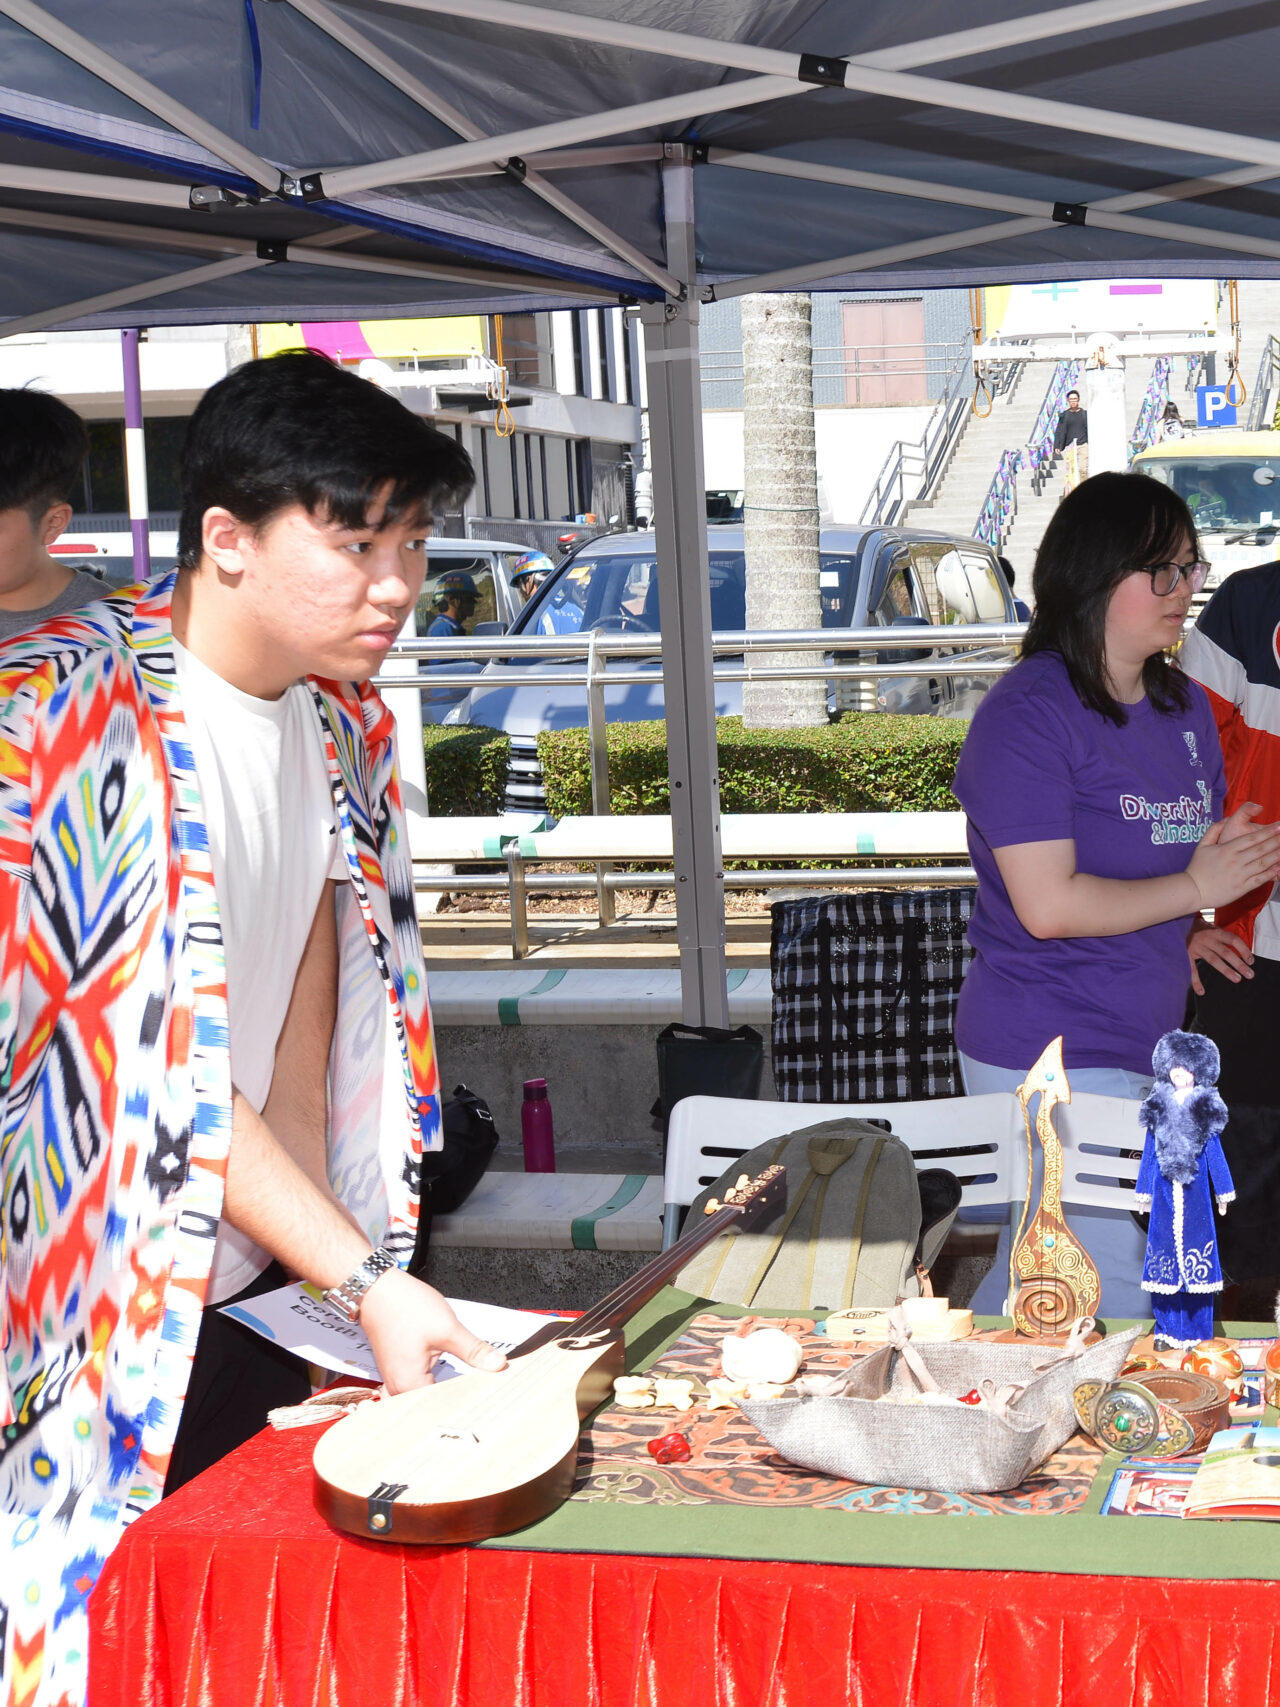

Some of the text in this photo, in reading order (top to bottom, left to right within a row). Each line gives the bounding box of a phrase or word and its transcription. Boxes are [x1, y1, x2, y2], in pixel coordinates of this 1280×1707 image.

[1205, 392, 1227, 420] P
[1120, 795, 1204, 822] Diversity
[289, 1304, 358, 1337] Booth
